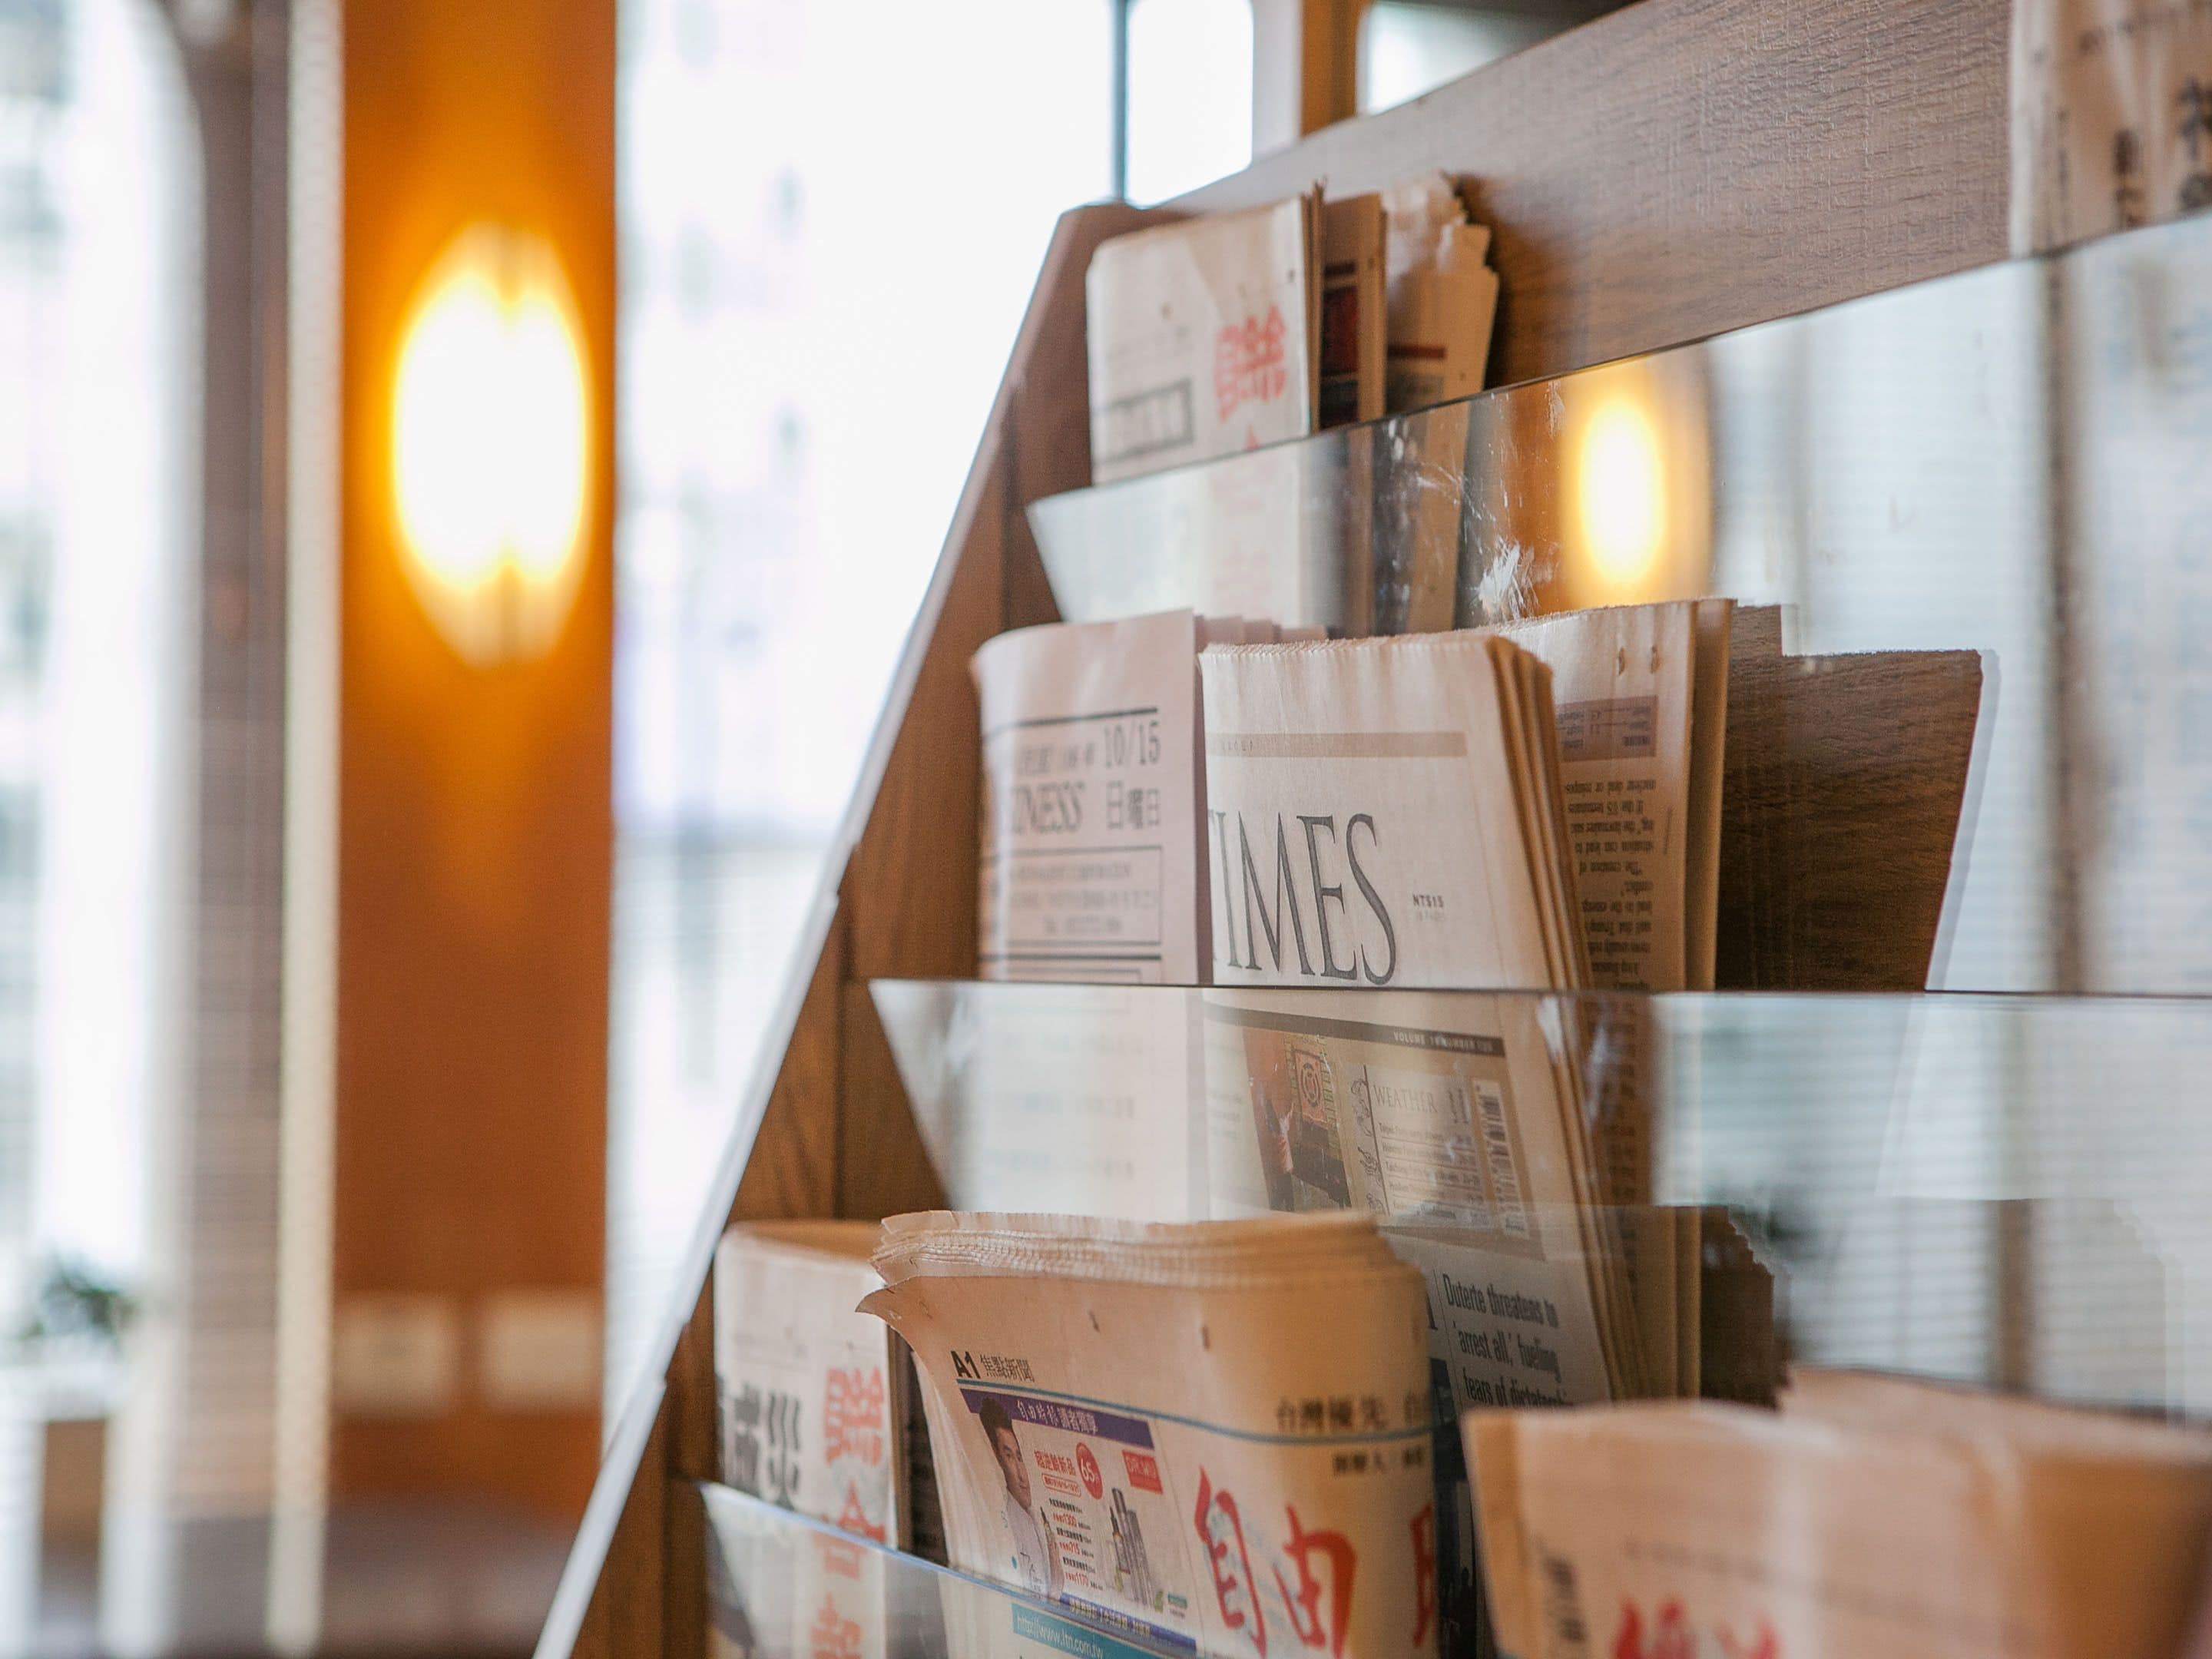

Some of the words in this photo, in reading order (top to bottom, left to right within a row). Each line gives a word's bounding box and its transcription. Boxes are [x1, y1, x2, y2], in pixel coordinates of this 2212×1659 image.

[1103, 720, 1161, 768] 10/15
[1209, 810, 1396, 985] IMES
[1393, 1031, 1426, 1045] VOLUME
[1371, 1084, 1439, 1114] WEATHER
[1442, 1273, 1487, 1314] Duterte
[1487, 1283, 1545, 1325] threatens
[950, 1350, 982, 1379] A1
[980, 1354, 1035, 1383] 焦點新聞
